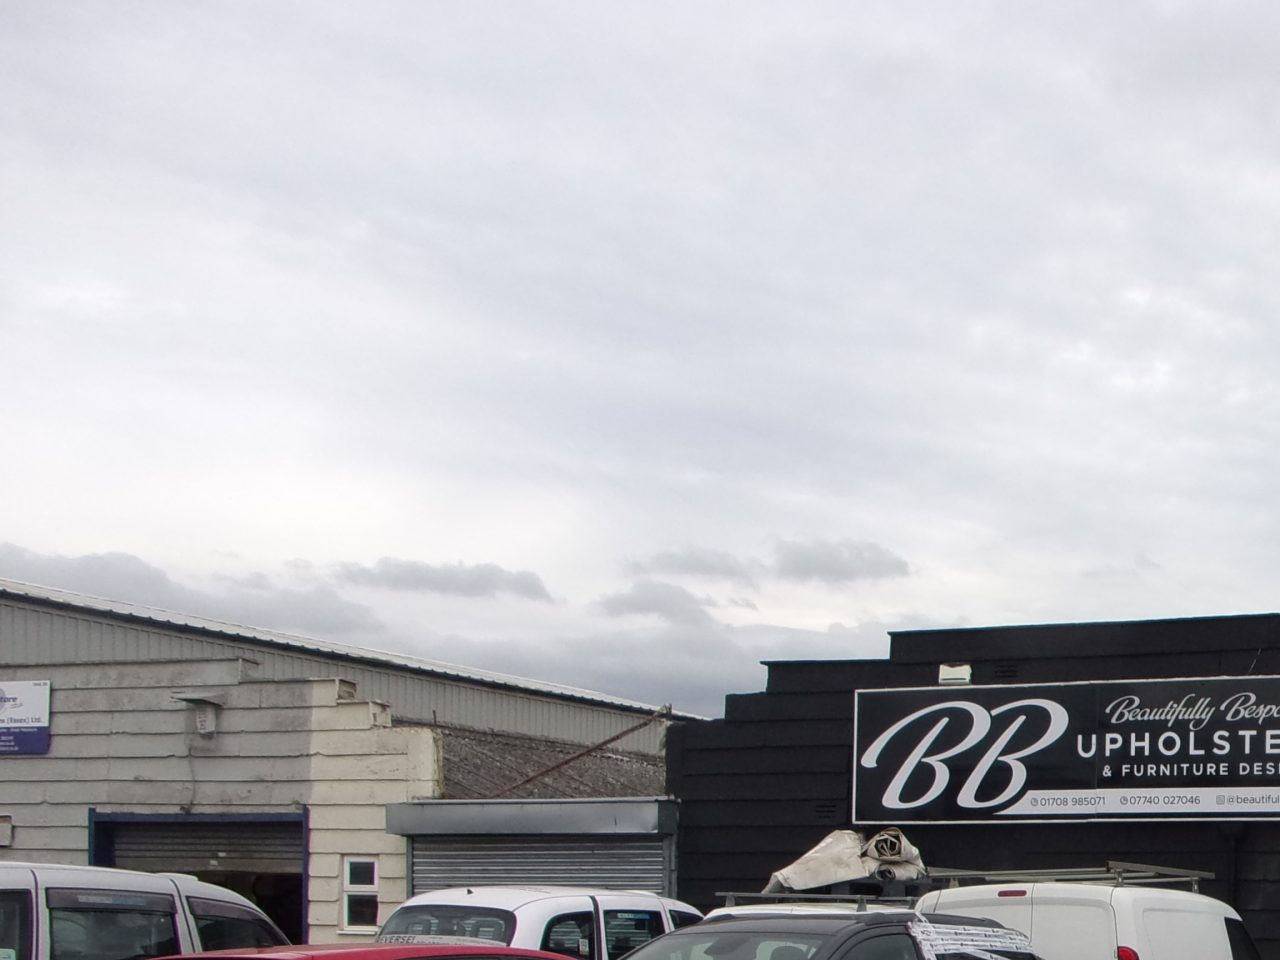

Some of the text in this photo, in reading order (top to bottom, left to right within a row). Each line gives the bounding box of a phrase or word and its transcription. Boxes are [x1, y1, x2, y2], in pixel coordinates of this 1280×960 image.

[1105, 695, 1216, 731] Beautifully
[861, 698, 1069, 809] BB
[1102, 765, 1113, 777] &
[1121, 763, 1230, 777] FURNITURE
[1040, 796, 1106, 807] 01708 985071
[1129, 795, 1201, 805] 07740 027046
